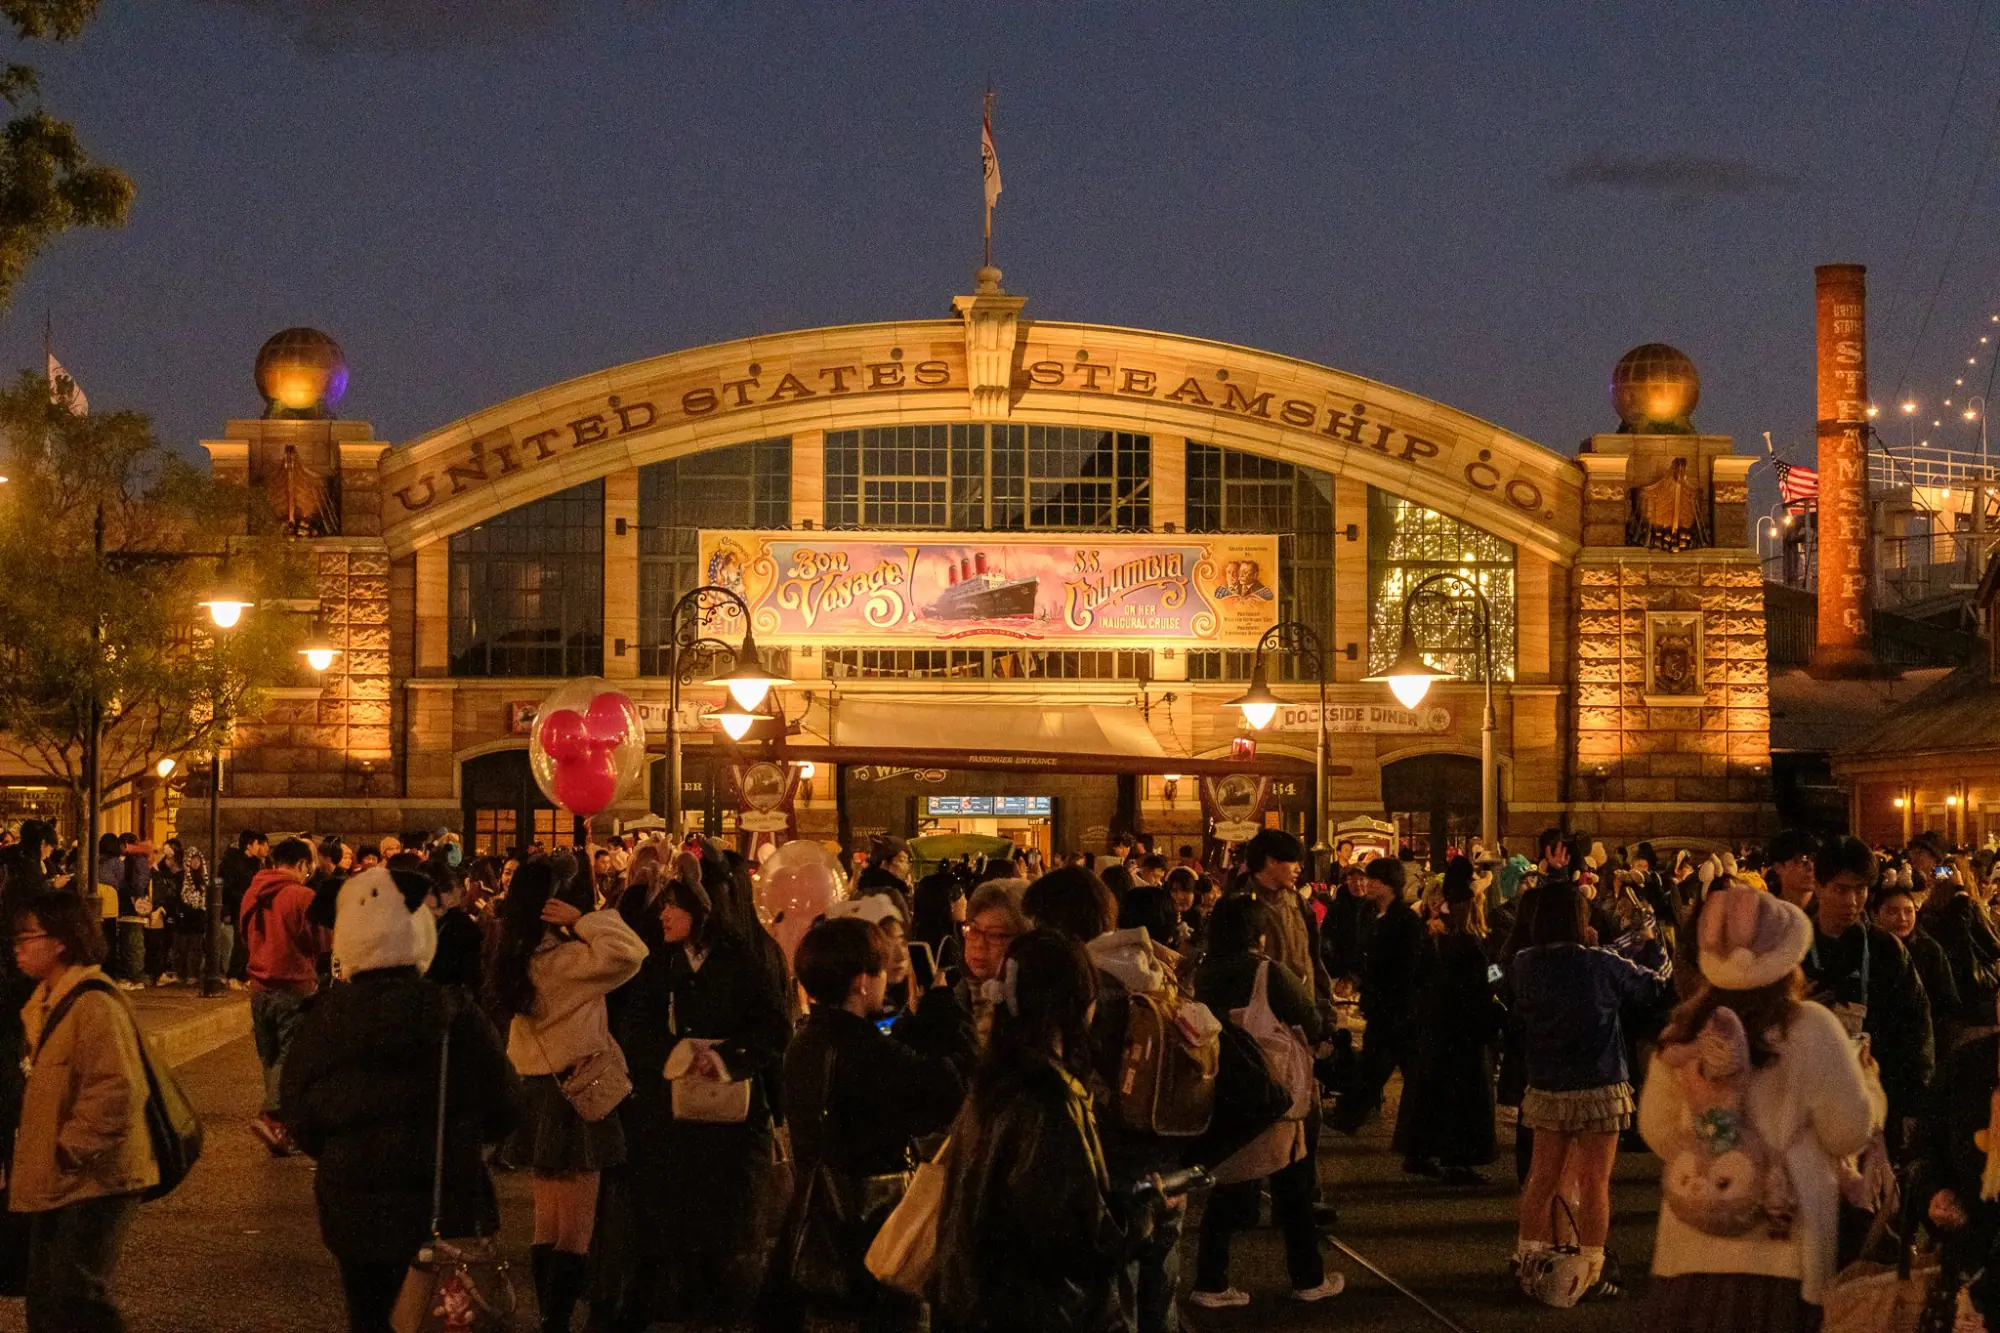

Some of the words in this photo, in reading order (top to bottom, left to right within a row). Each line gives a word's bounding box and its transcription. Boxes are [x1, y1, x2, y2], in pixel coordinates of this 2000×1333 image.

[393, 401, 659, 511] UNITED
[681, 360, 951, 415] STATES
[1028, 361, 1440, 463] STEAMSHIP
[1464, 462, 1554, 520] CO.
[787, 548, 850, 579] Bon
[1073, 550, 1102, 573] S.S.
[777, 547, 920, 628] Voyage!
[1124, 604, 1135, 616] ON
[1139, 604, 1156, 616] HER
[1099, 617, 1147, 629] INAUGURAL
[1149, 617, 1181, 629] CRUISE
[1370, 706, 1418, 727] DINER
[968, 755, 1013, 764] PASSENGER
[1015, 757, 1058, 765] ENTRANCE
